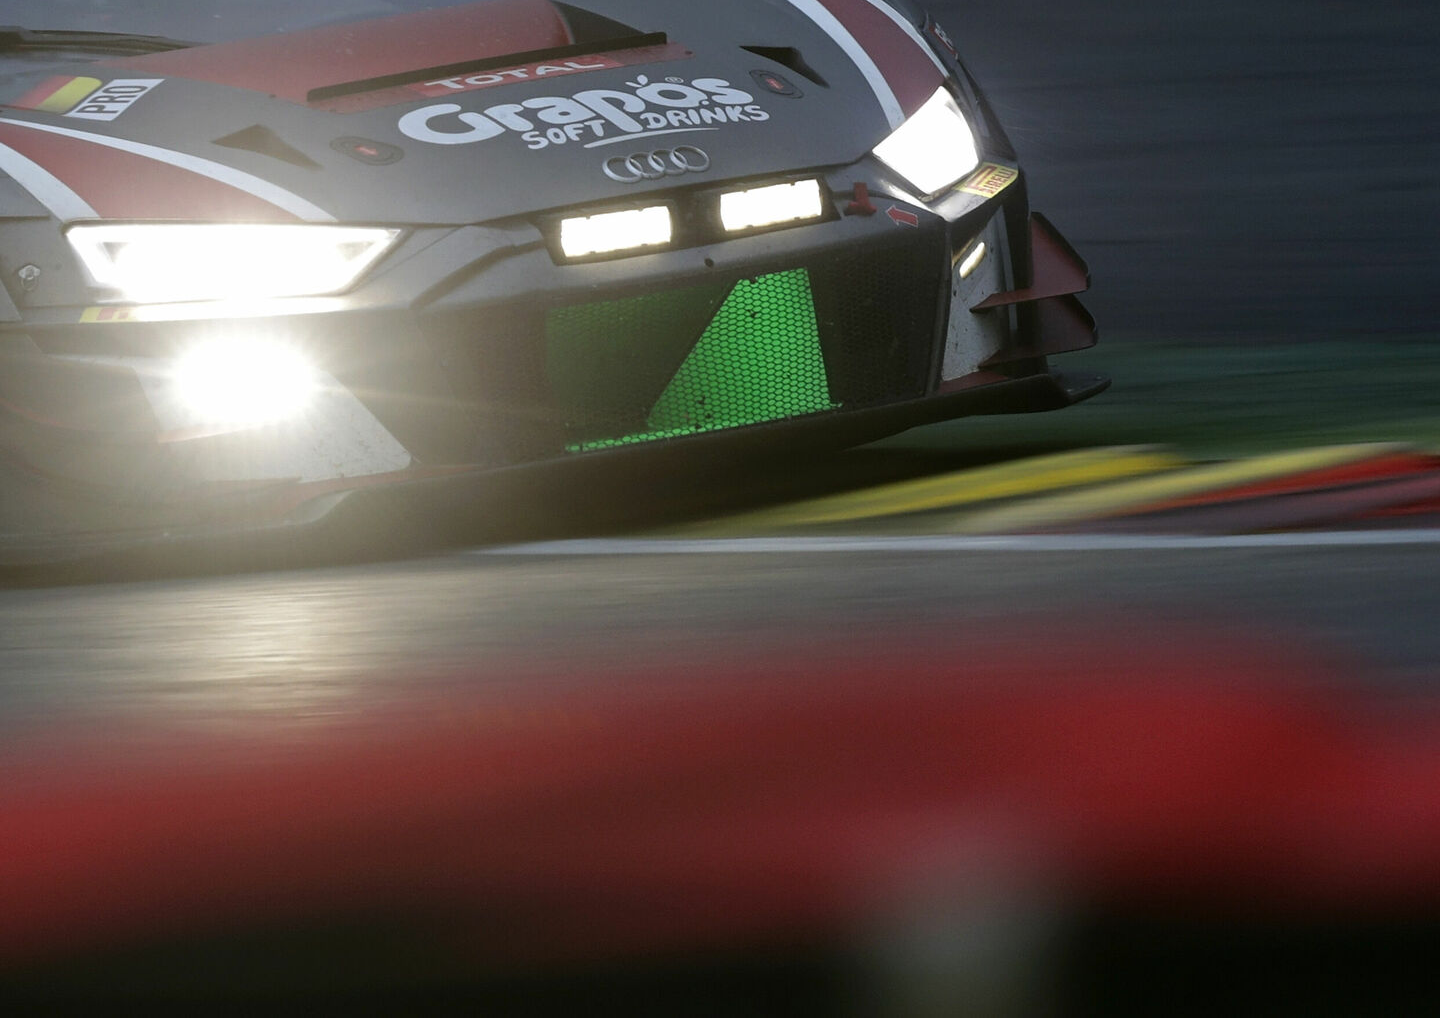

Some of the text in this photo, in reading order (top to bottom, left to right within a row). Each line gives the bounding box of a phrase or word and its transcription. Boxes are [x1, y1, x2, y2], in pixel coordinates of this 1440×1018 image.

[424, 60, 606, 90] TOTAL
[75, 84, 149, 115] PRO
[521, 103, 771, 151] SOFT DRINKS
